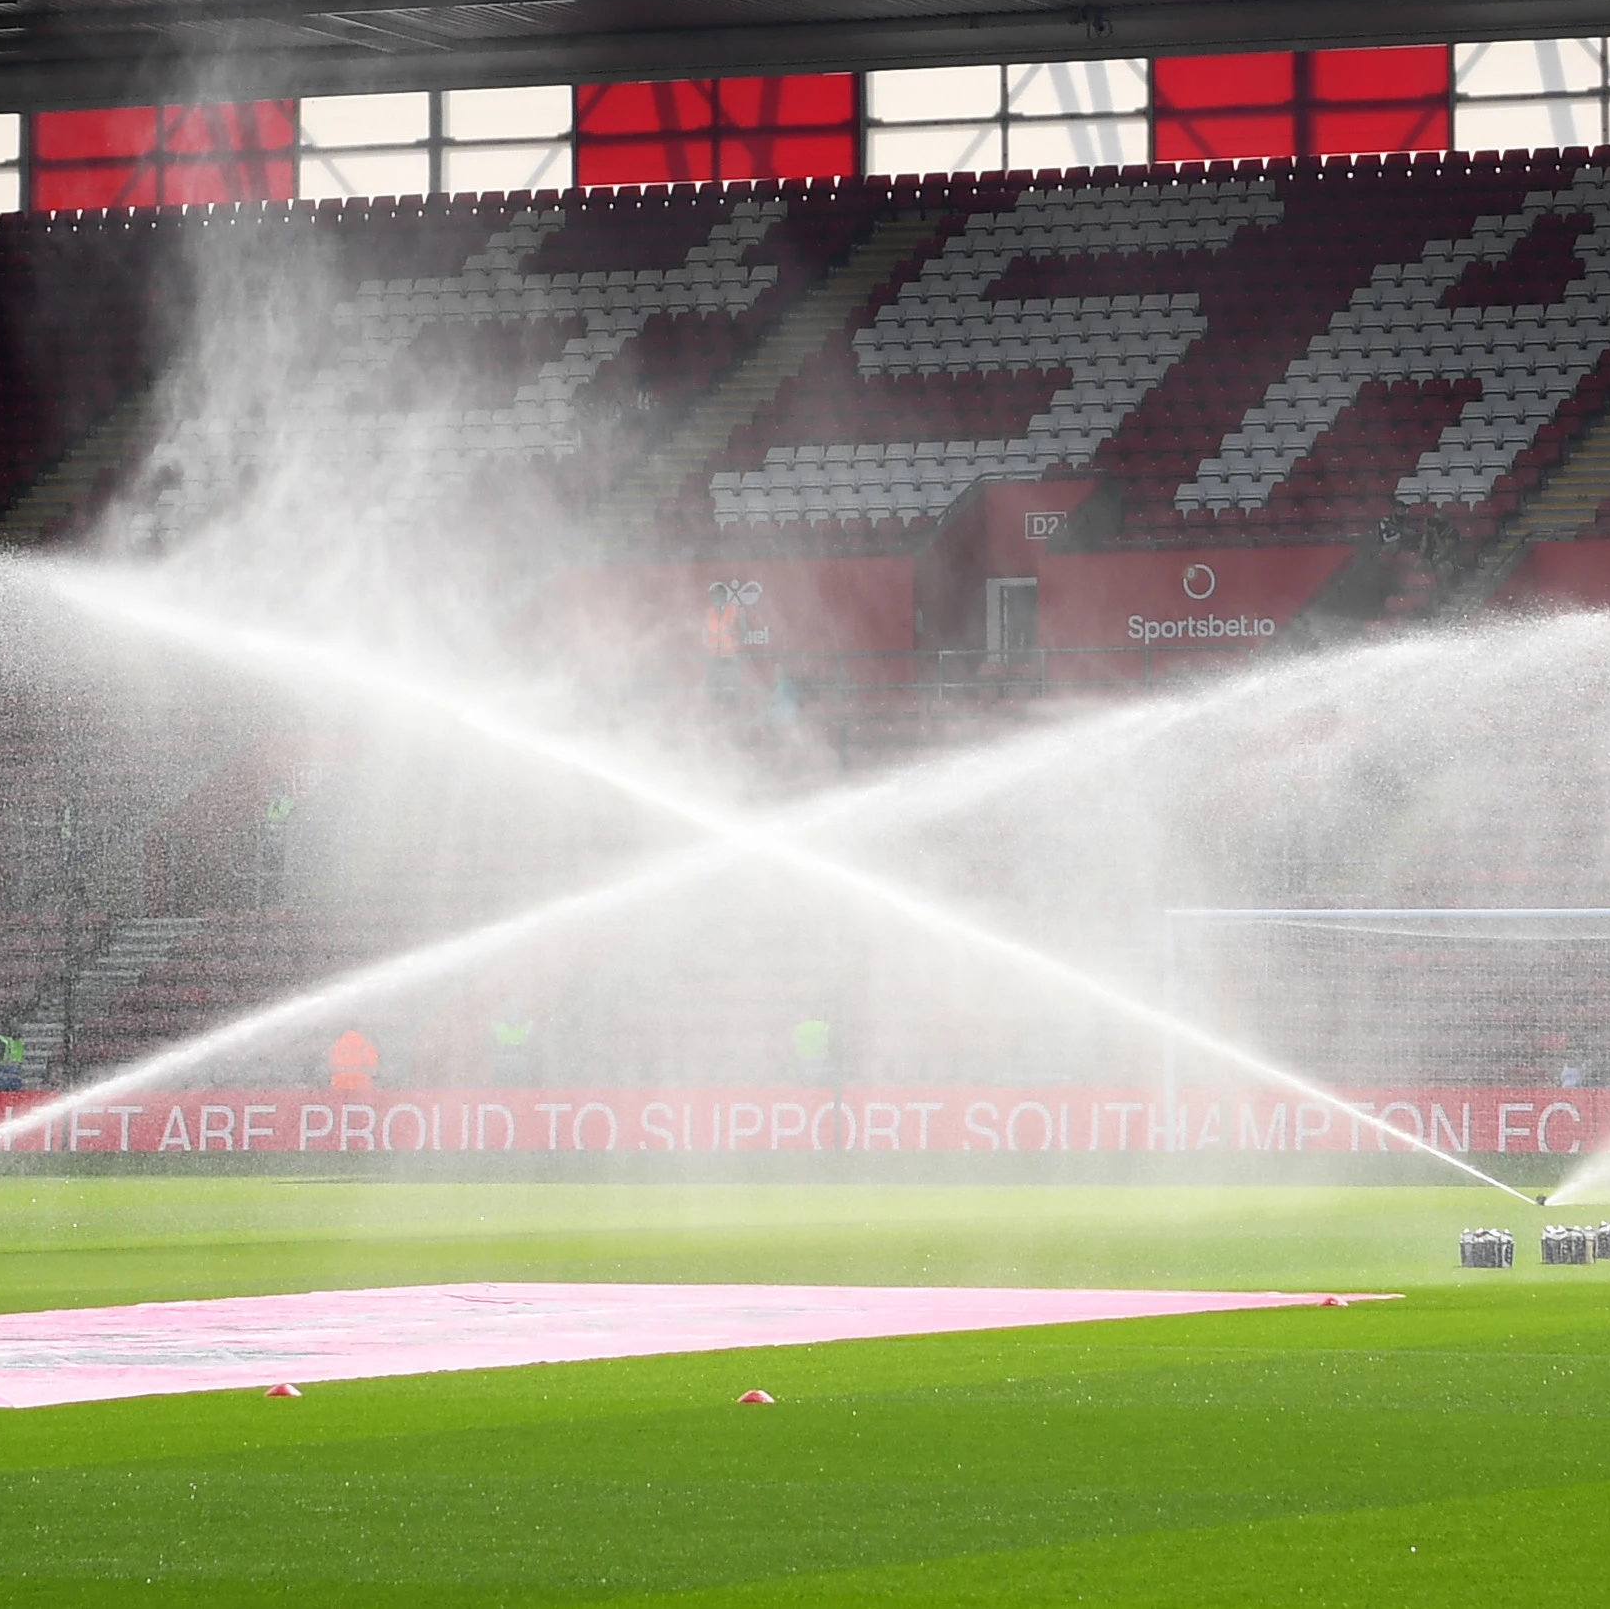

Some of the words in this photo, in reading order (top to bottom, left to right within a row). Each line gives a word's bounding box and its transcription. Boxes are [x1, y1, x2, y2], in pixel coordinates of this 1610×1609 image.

[1032, 515, 1059, 536] D2
[1127, 613, 1276, 645] Sportsbet.io
[158, 1105, 278, 1151] ARE
[298, 1103, 515, 1151] PROUD
[534, 1102, 619, 1150] TO
[639, 1102, 945, 1151] SUPPORT
[962, 1101, 1470, 1152] SOUTHAMPTON
[1498, 1102, 1581, 1153] FC
